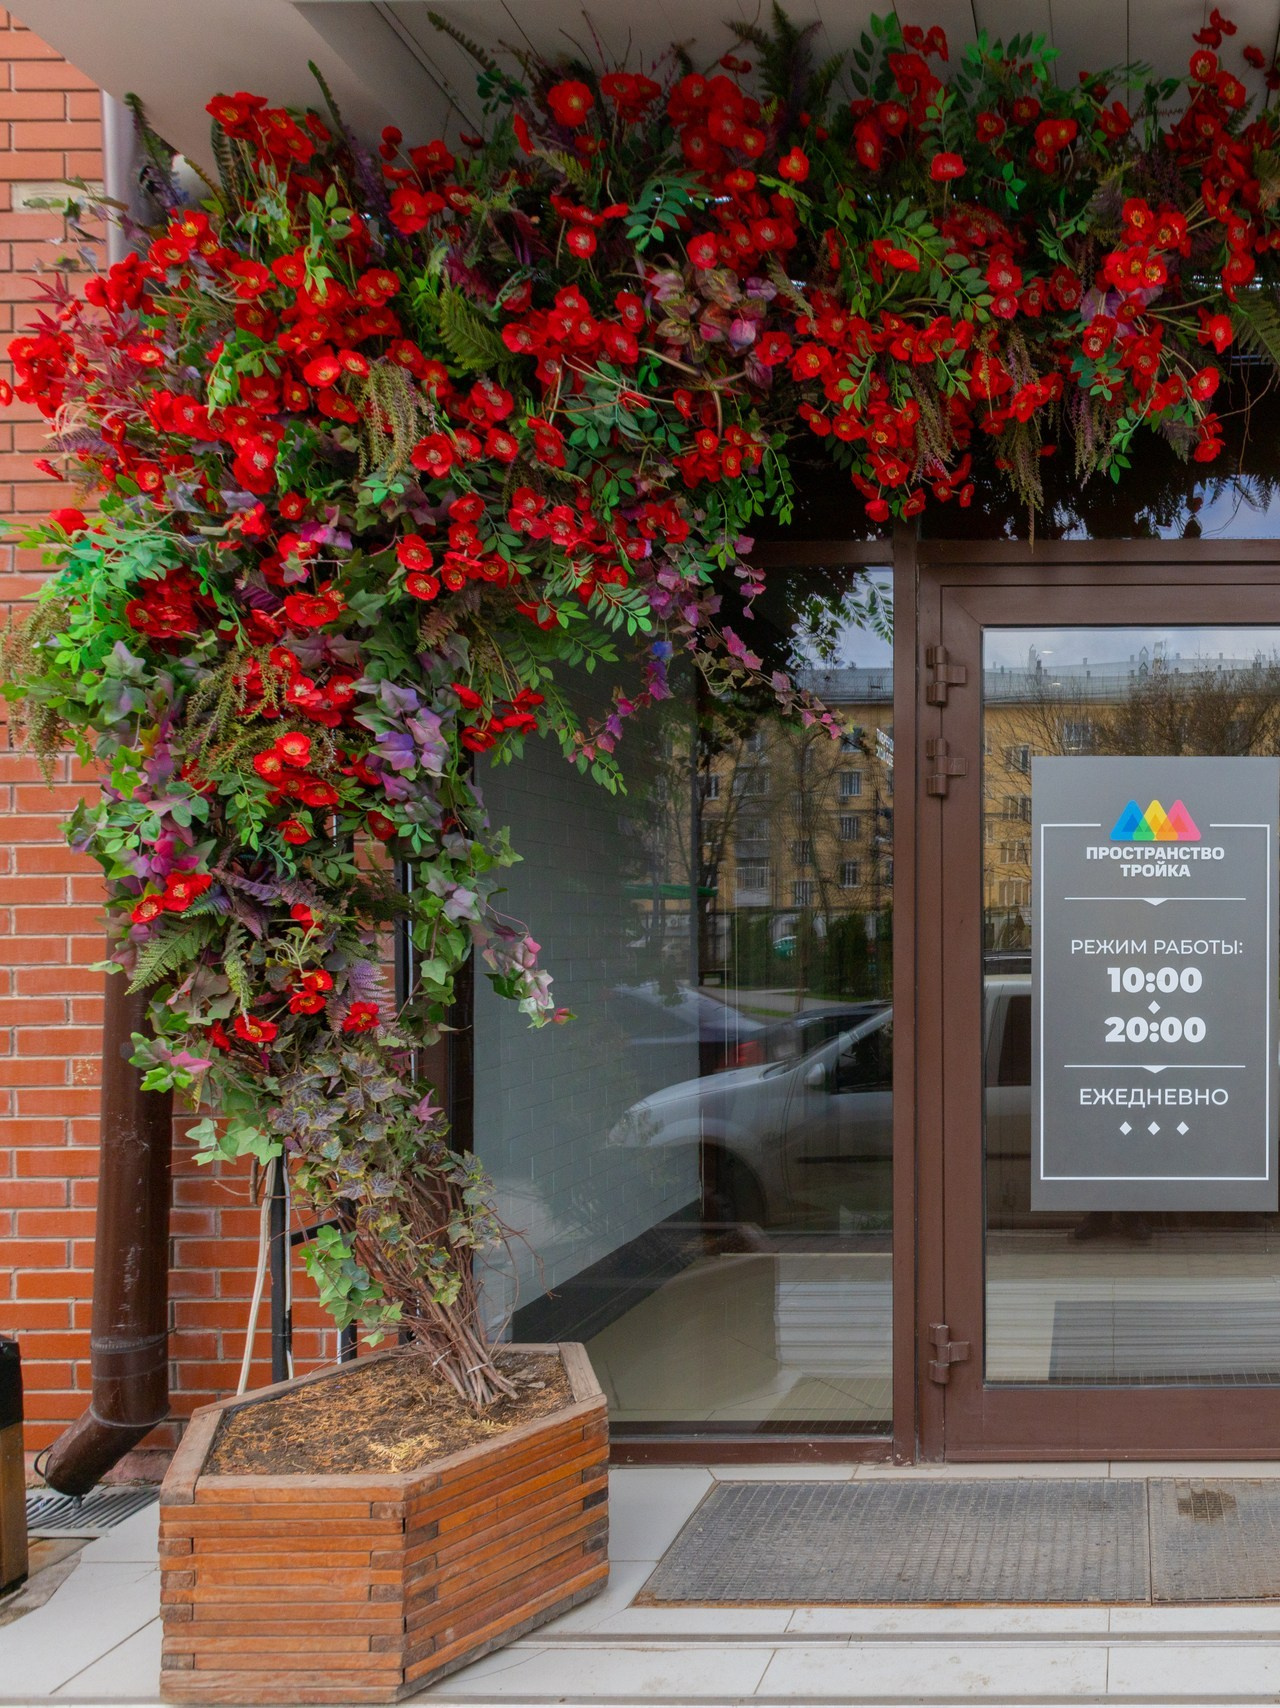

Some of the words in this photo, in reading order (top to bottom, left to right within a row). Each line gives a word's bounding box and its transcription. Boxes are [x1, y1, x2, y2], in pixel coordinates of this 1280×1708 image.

[1087, 847, 1224, 859] ПРОСТРАНСТВО
[1120, 861, 1191, 877] ТРОЙКА
[1072, 940, 1146, 954] РЕЖИМ
[1155, 940, 1242, 954] РАБОТЫ:
[1107, 967, 1202, 993] 10:00
[1104, 1017, 1206, 1043] 20:00
[1080, 1089, 1228, 1108] ЕЖЕДНЕВНО
